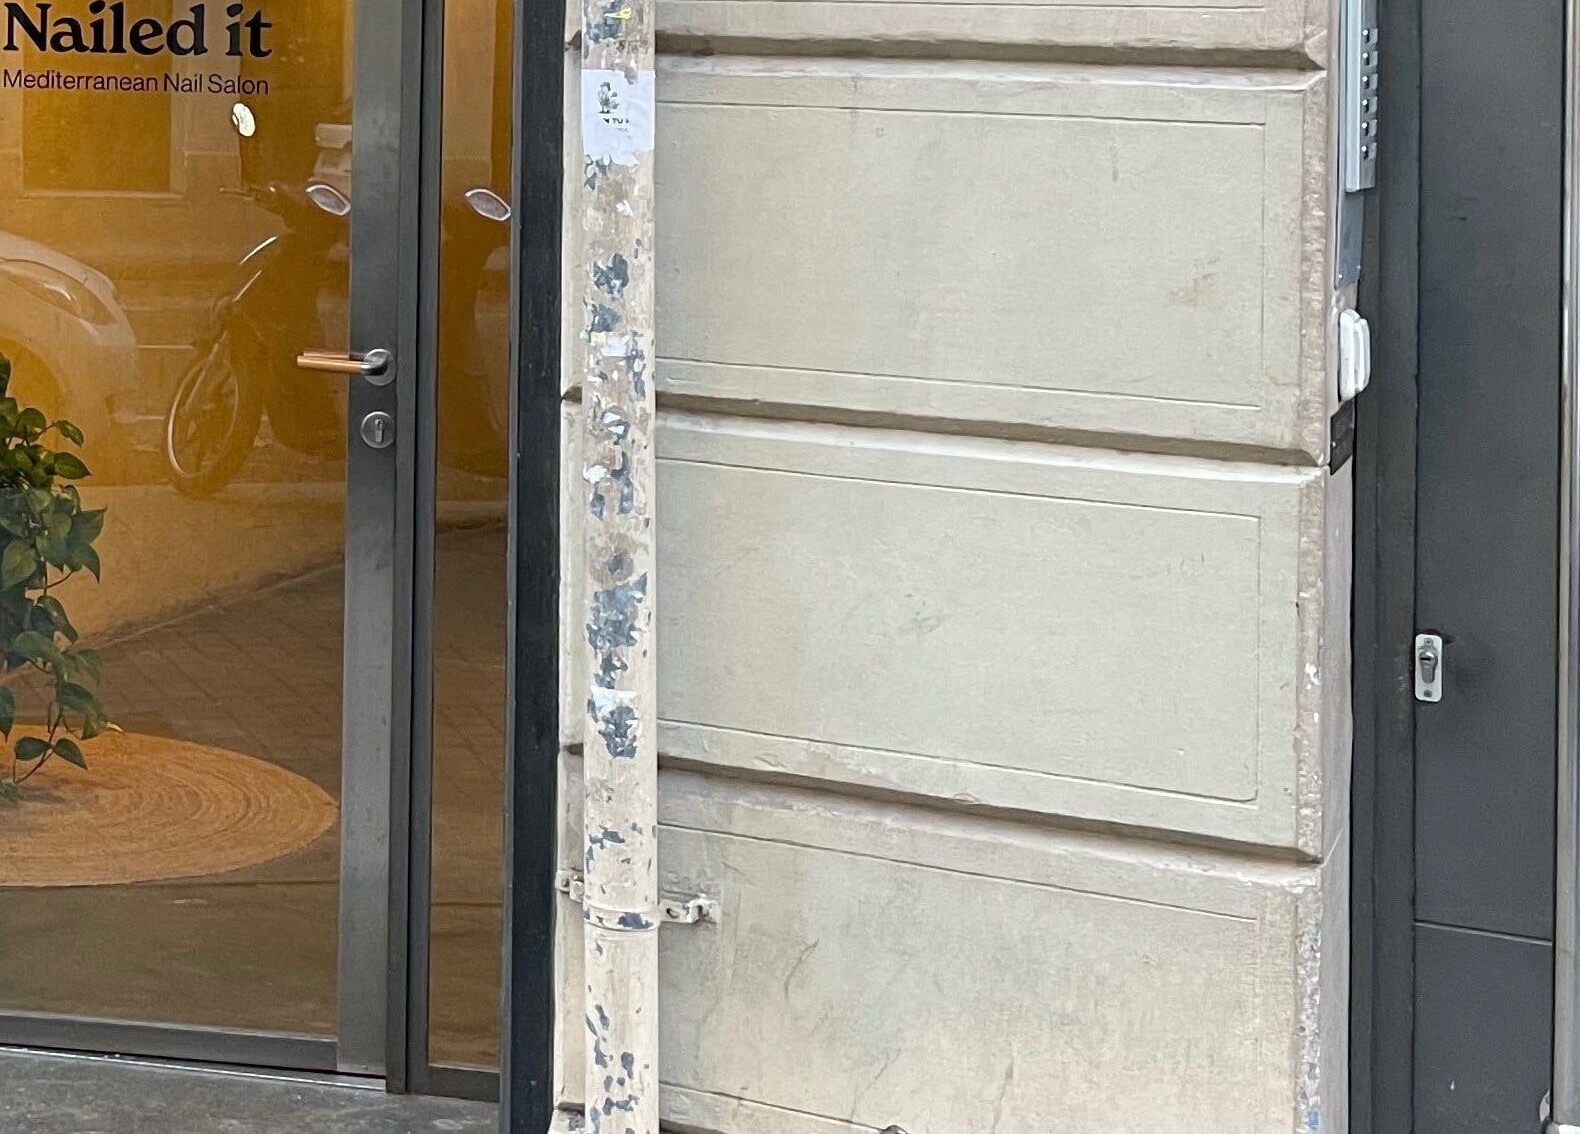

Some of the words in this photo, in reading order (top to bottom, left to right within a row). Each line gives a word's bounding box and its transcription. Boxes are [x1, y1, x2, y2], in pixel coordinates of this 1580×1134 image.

[2, 0, 209, 54] Nailed
[224, 2, 273, 58] it
[2, 68, 159, 93] Mediterranean
[163, 72, 203, 94] Nail
[208, 73, 270, 96] Salon
